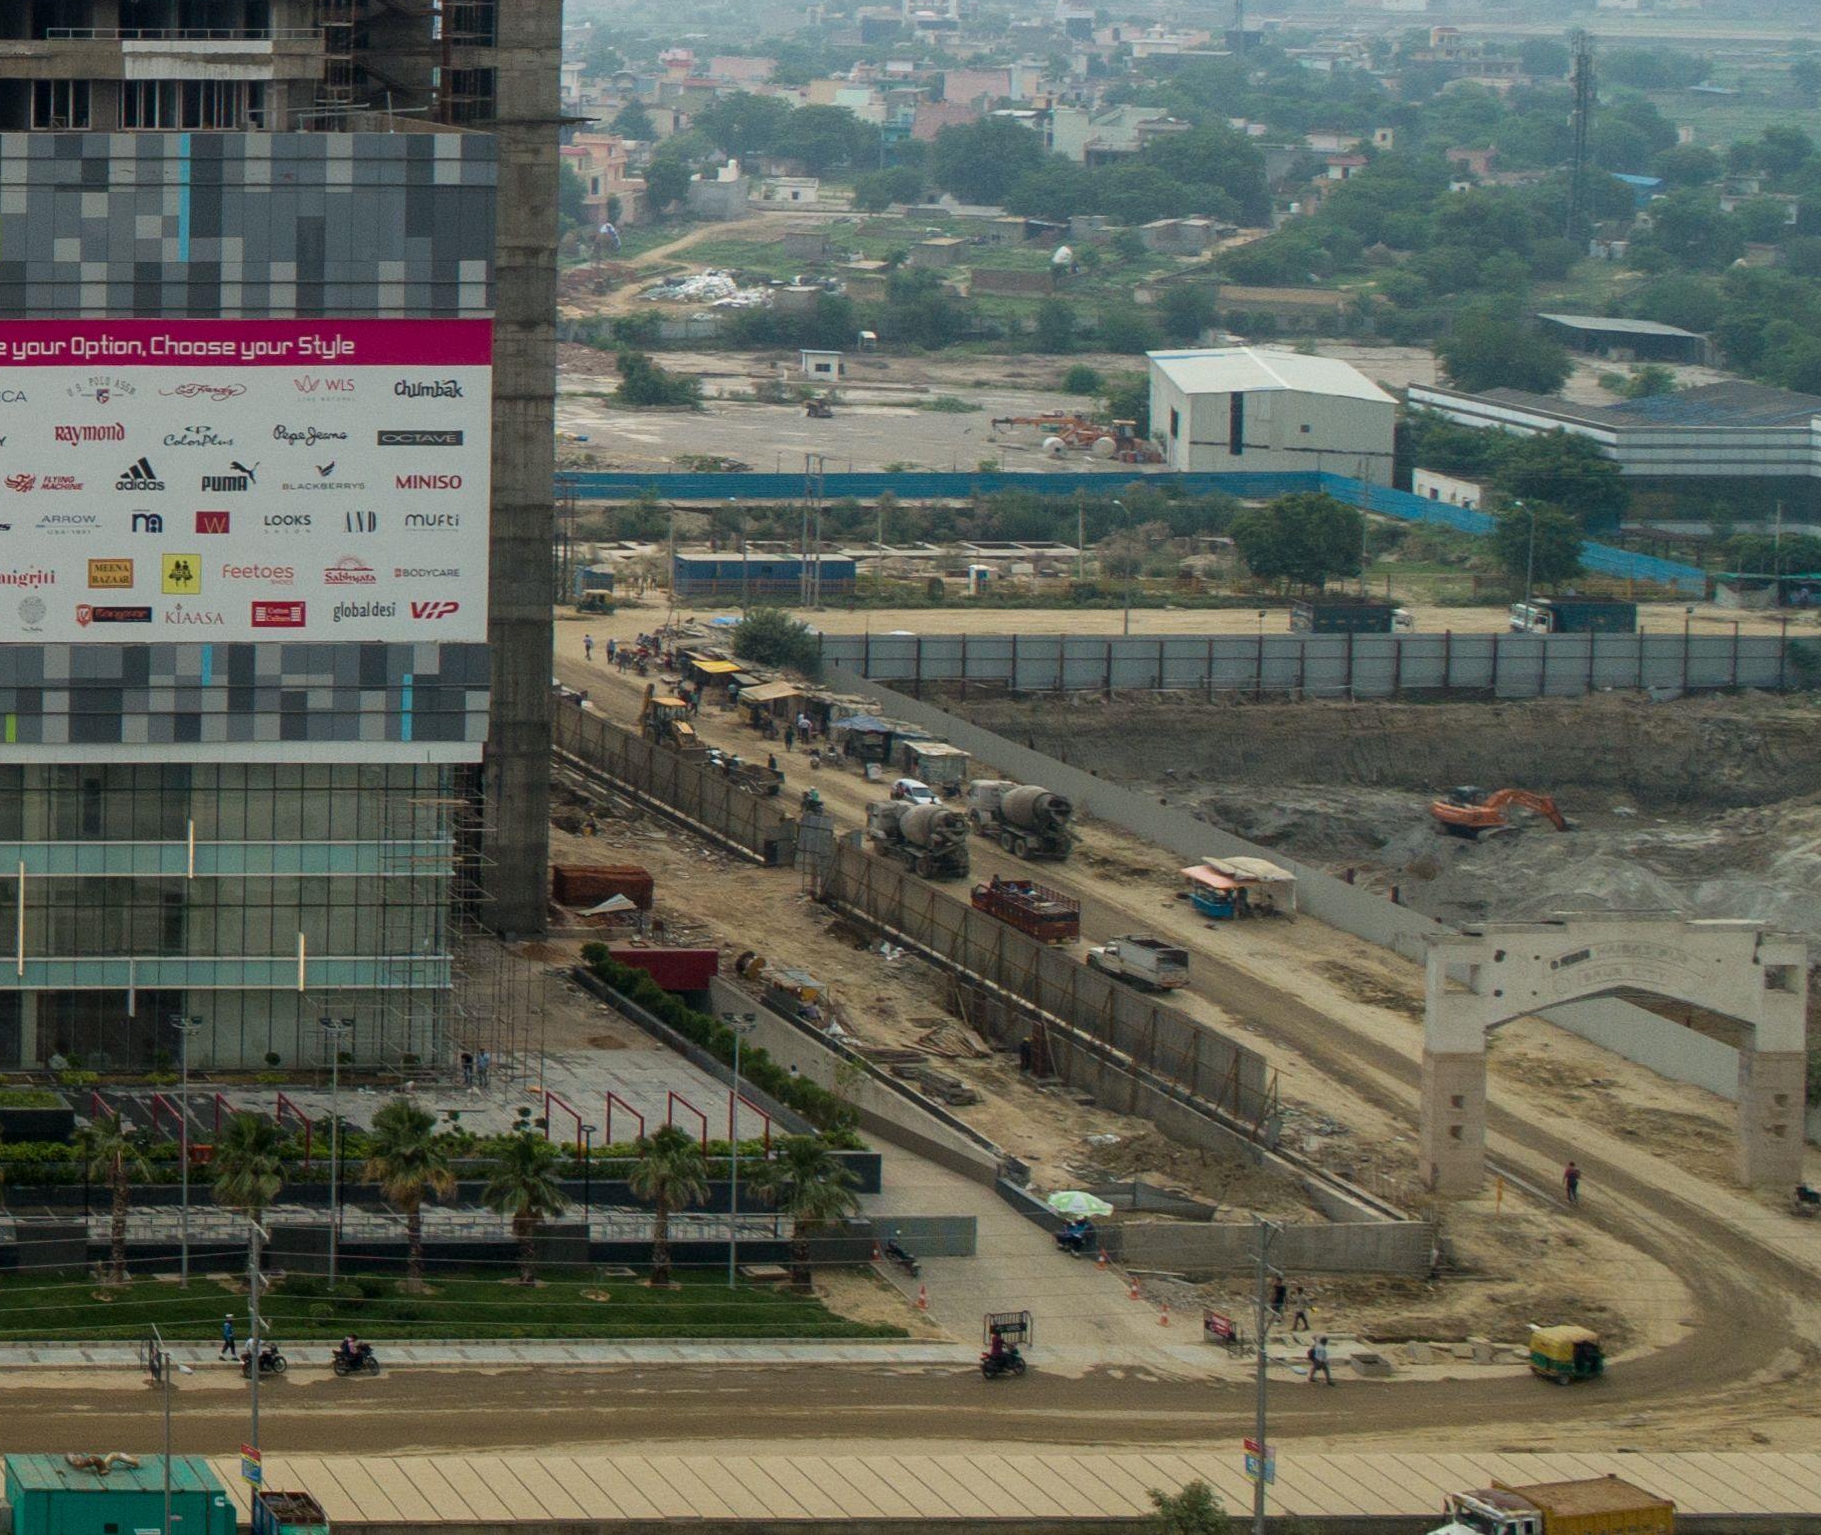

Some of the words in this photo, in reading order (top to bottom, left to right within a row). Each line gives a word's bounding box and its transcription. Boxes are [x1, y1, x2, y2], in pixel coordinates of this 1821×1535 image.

[12, 338, 66, 360] your
[71, 336, 147, 360] Option,
[150, 334, 236, 356] Choose
[241, 338, 294, 360] your
[298, 335, 355, 359] Style
[88, 376, 111, 388] POLO
[325, 378, 355, 392] WLS
[55, 422, 125, 446] Raymond
[273, 424, 305, 446] Pepe
[305, 426, 349, 447] Jeans
[115, 479, 165, 491] adidas
[202, 476, 248, 492] PUMA
[395, 475, 462, 490] MINISO
[42, 515, 97, 524] ARROW
[203, 517, 226, 534] W
[264, 515, 312, 526] LOOKS
[93, 564, 129, 572] MEENA
[222, 564, 294, 579] Feetoes
[403, 568, 460, 577] BODYCARE
[92, 575, 130, 584] BAZAAR
[333, 601, 370, 622] global
[371, 602, 396, 617] desi
[410, 601, 460, 619] VIP
